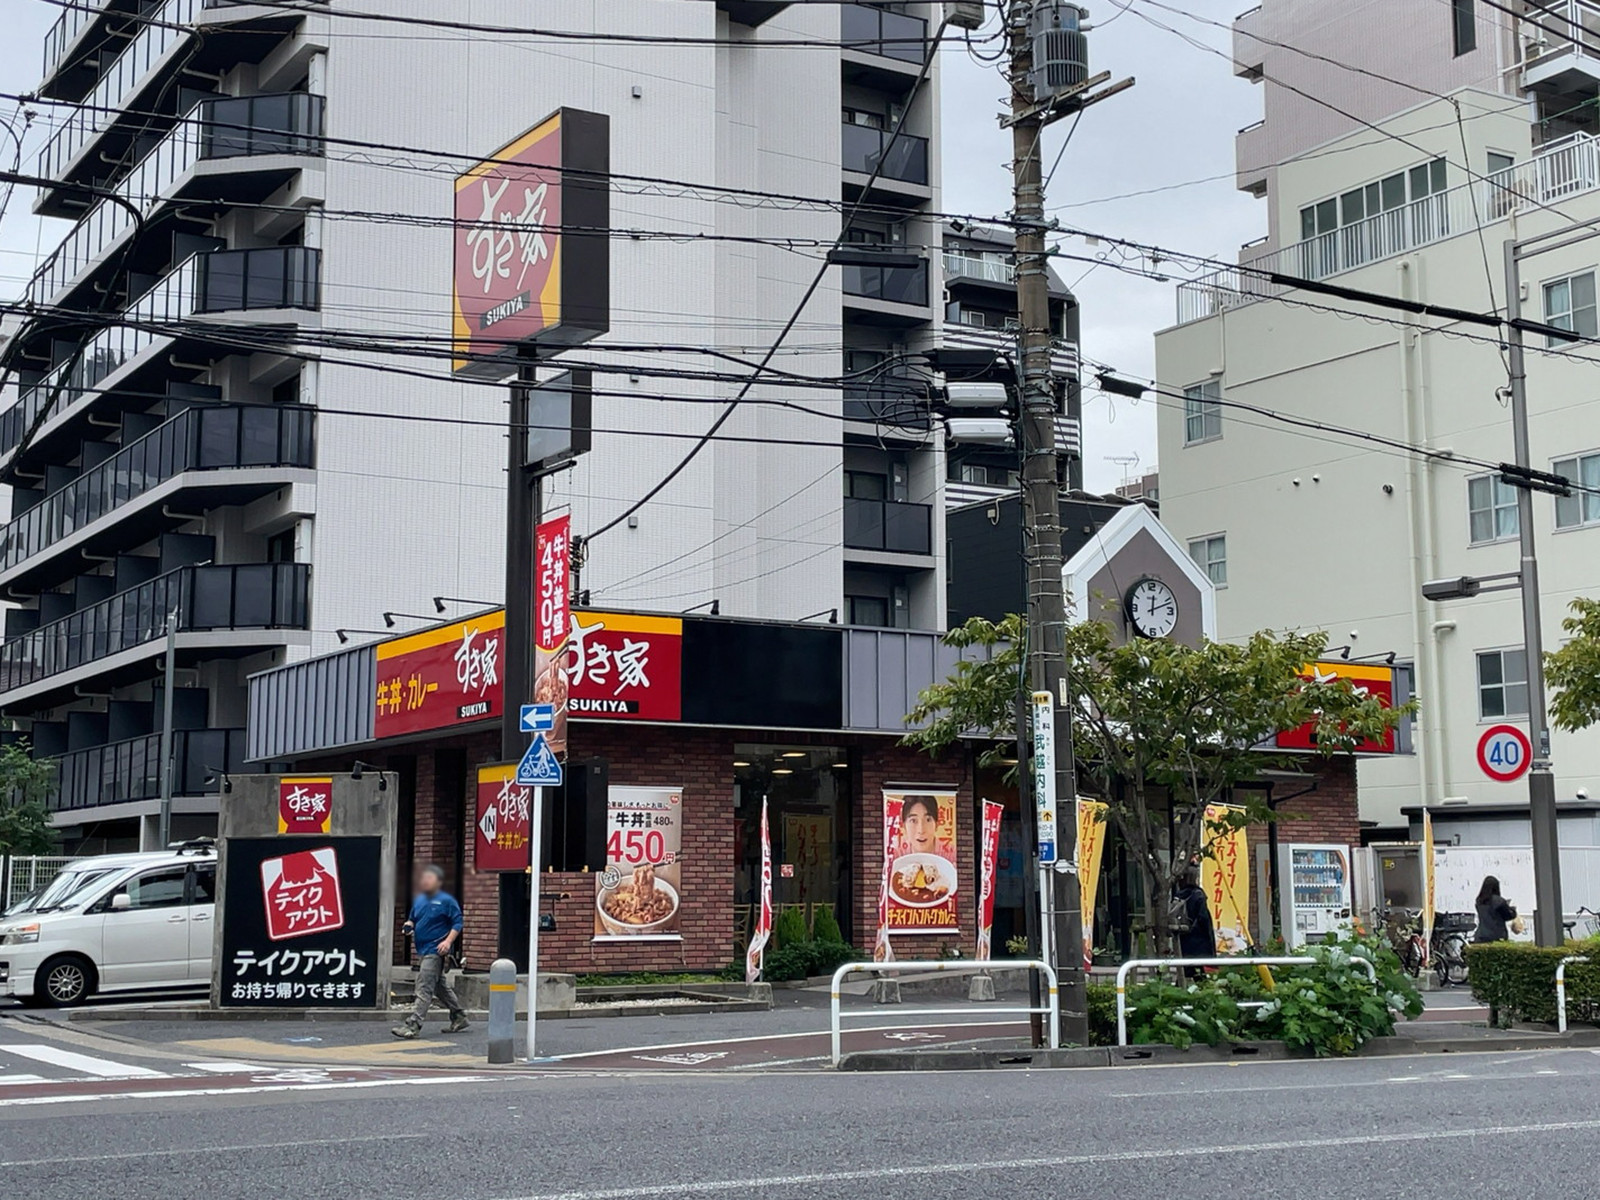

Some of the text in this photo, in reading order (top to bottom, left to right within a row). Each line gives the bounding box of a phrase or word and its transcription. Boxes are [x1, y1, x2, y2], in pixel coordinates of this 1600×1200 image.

[467, 176, 547, 293] すき家
[486, 295, 524, 326] SUKIYA
[1166, 606, 1174, 615] 3
[1149, 627, 1157, 637] 6
[454, 624, 498, 697] すき家
[568, 613, 651, 696] すき家
[376, 673, 438, 716] 牛丼・カレー
[569, 698, 629, 713] SUKIYA
[461, 702, 488, 718] SUKIYA
[1489, 741, 1519, 766] 40
[286, 785, 327, 816] すき家
[497, 775, 530, 828] すき家
[484, 815, 496, 833] IN
[616, 811, 645, 828] 牛丼
[607, 830, 675, 864] 450円
[275, 886, 323, 912] テイク
[285, 906, 334, 930] アウト
[233, 948, 367, 977] テイクアウト
[231, 982, 366, 1000] お持ち帰りできます
